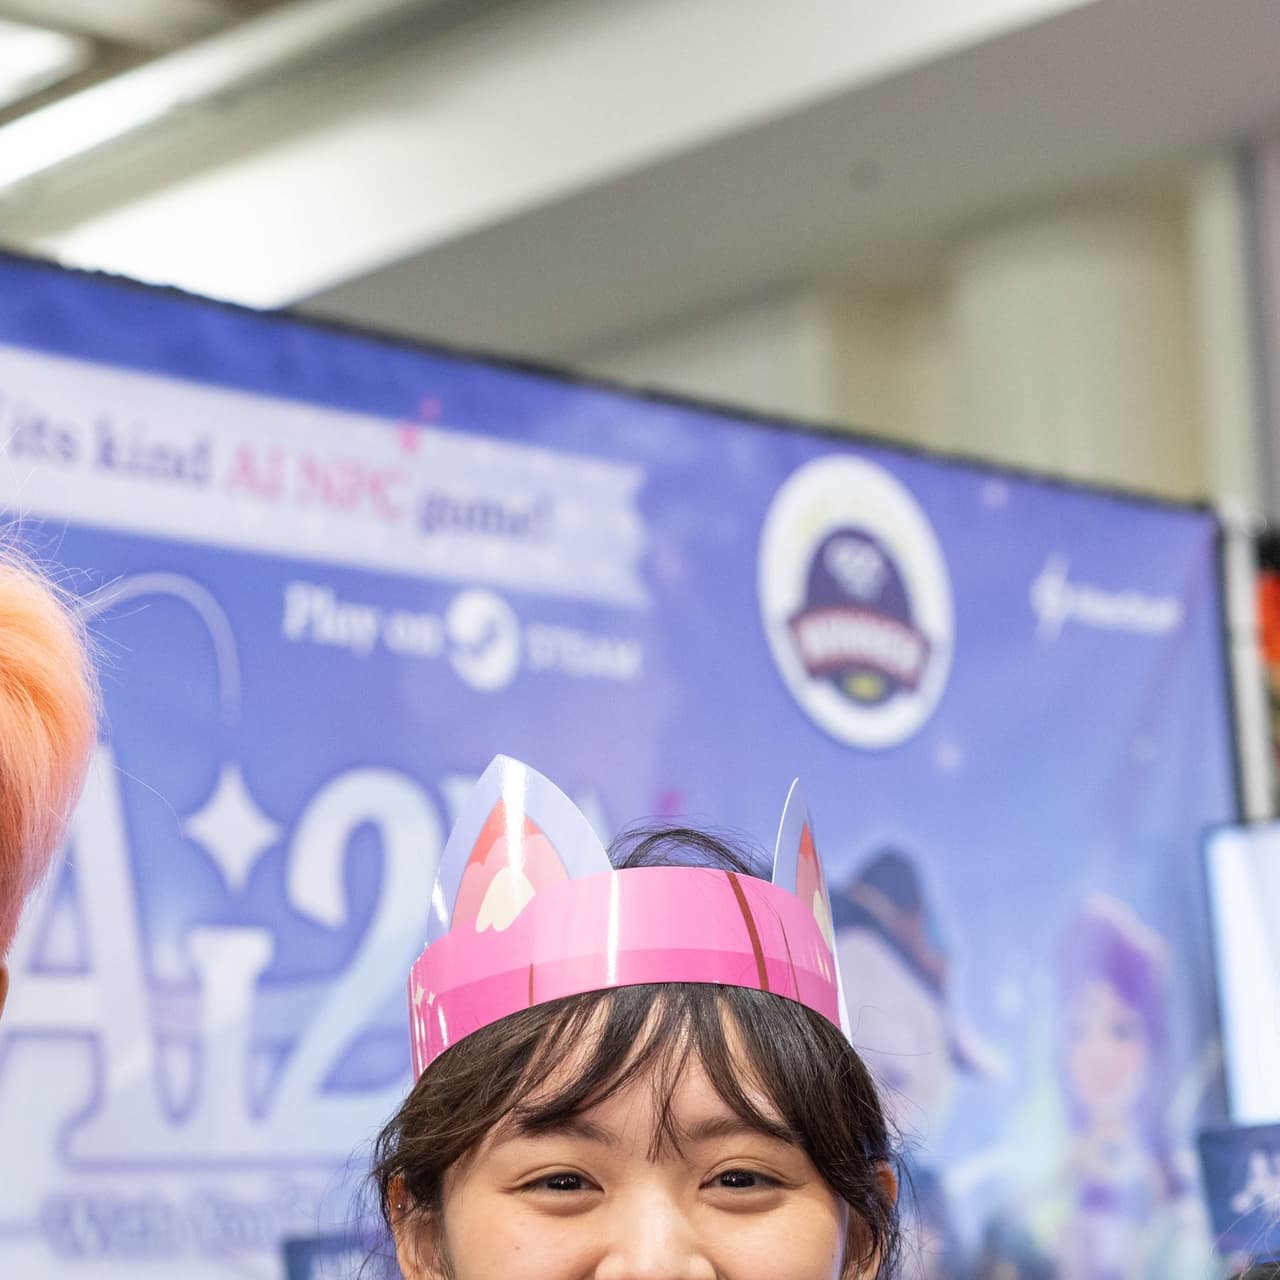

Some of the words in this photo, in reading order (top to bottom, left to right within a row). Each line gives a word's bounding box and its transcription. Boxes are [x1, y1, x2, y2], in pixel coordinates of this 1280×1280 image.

[10, 398, 80, 466] its
[92, 413, 212, 487] kind
[227, 443, 284, 498] AI
